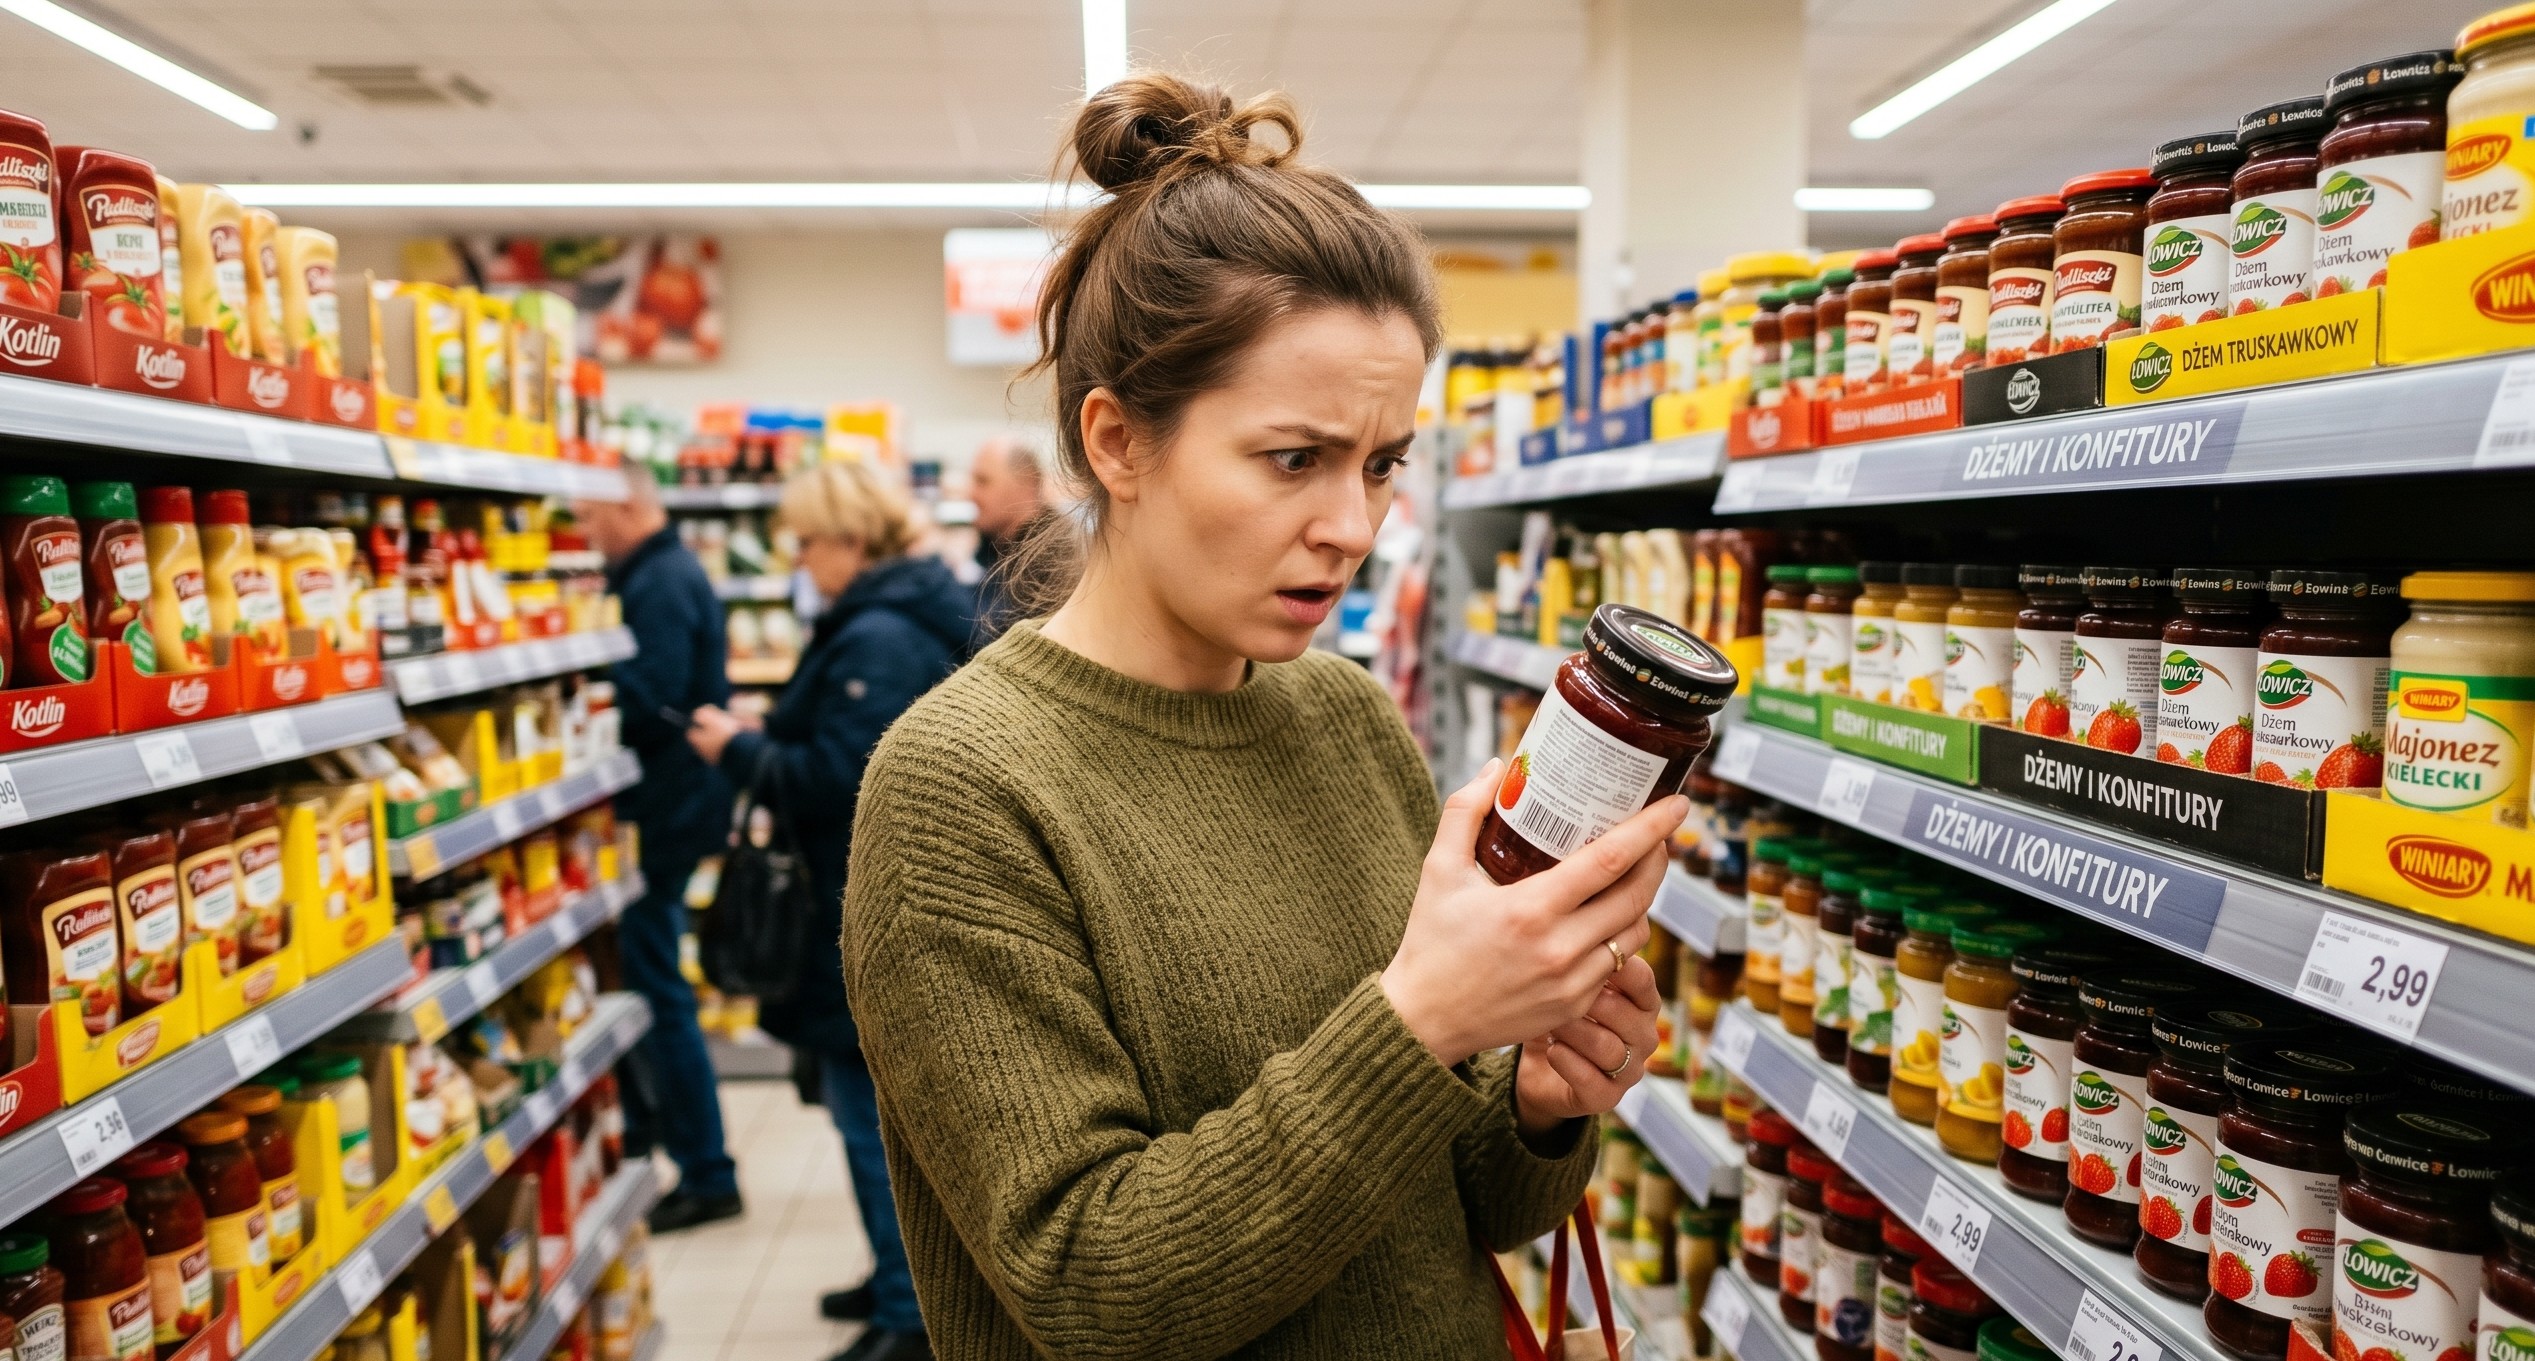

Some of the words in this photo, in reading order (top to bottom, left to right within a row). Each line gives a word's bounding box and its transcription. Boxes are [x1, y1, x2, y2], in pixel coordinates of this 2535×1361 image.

[0, 316, 61, 359] Kotlin
[2182, 341, 2224, 372] DŻEM
[1962, 435, 2044, 481] DŻEMY
[2039, 437, 2055, 474] I
[2052, 418, 2218, 473] KONFITURY
[11, 696, 66, 731] Kotlin
[2261, 713, 2296, 731] Dżem
[2024, 749, 2084, 795] DŻEMY
[2088, 769, 2093, 799] I
[2098, 772, 2224, 831] KONFITURY
[2387, 761, 2482, 791] KIELECKI
[1924, 801, 2004, 860] DŻEMY
[1998, 828, 2014, 865] I
[2010, 831, 2170, 919] KONFITURY
[2400, 845, 2488, 886] WINIARY
[2504, 862, 2535, 904] M
[2361, 955, 2429, 1008] 2,99
[1950, 1213, 1982, 1252] 2,99
